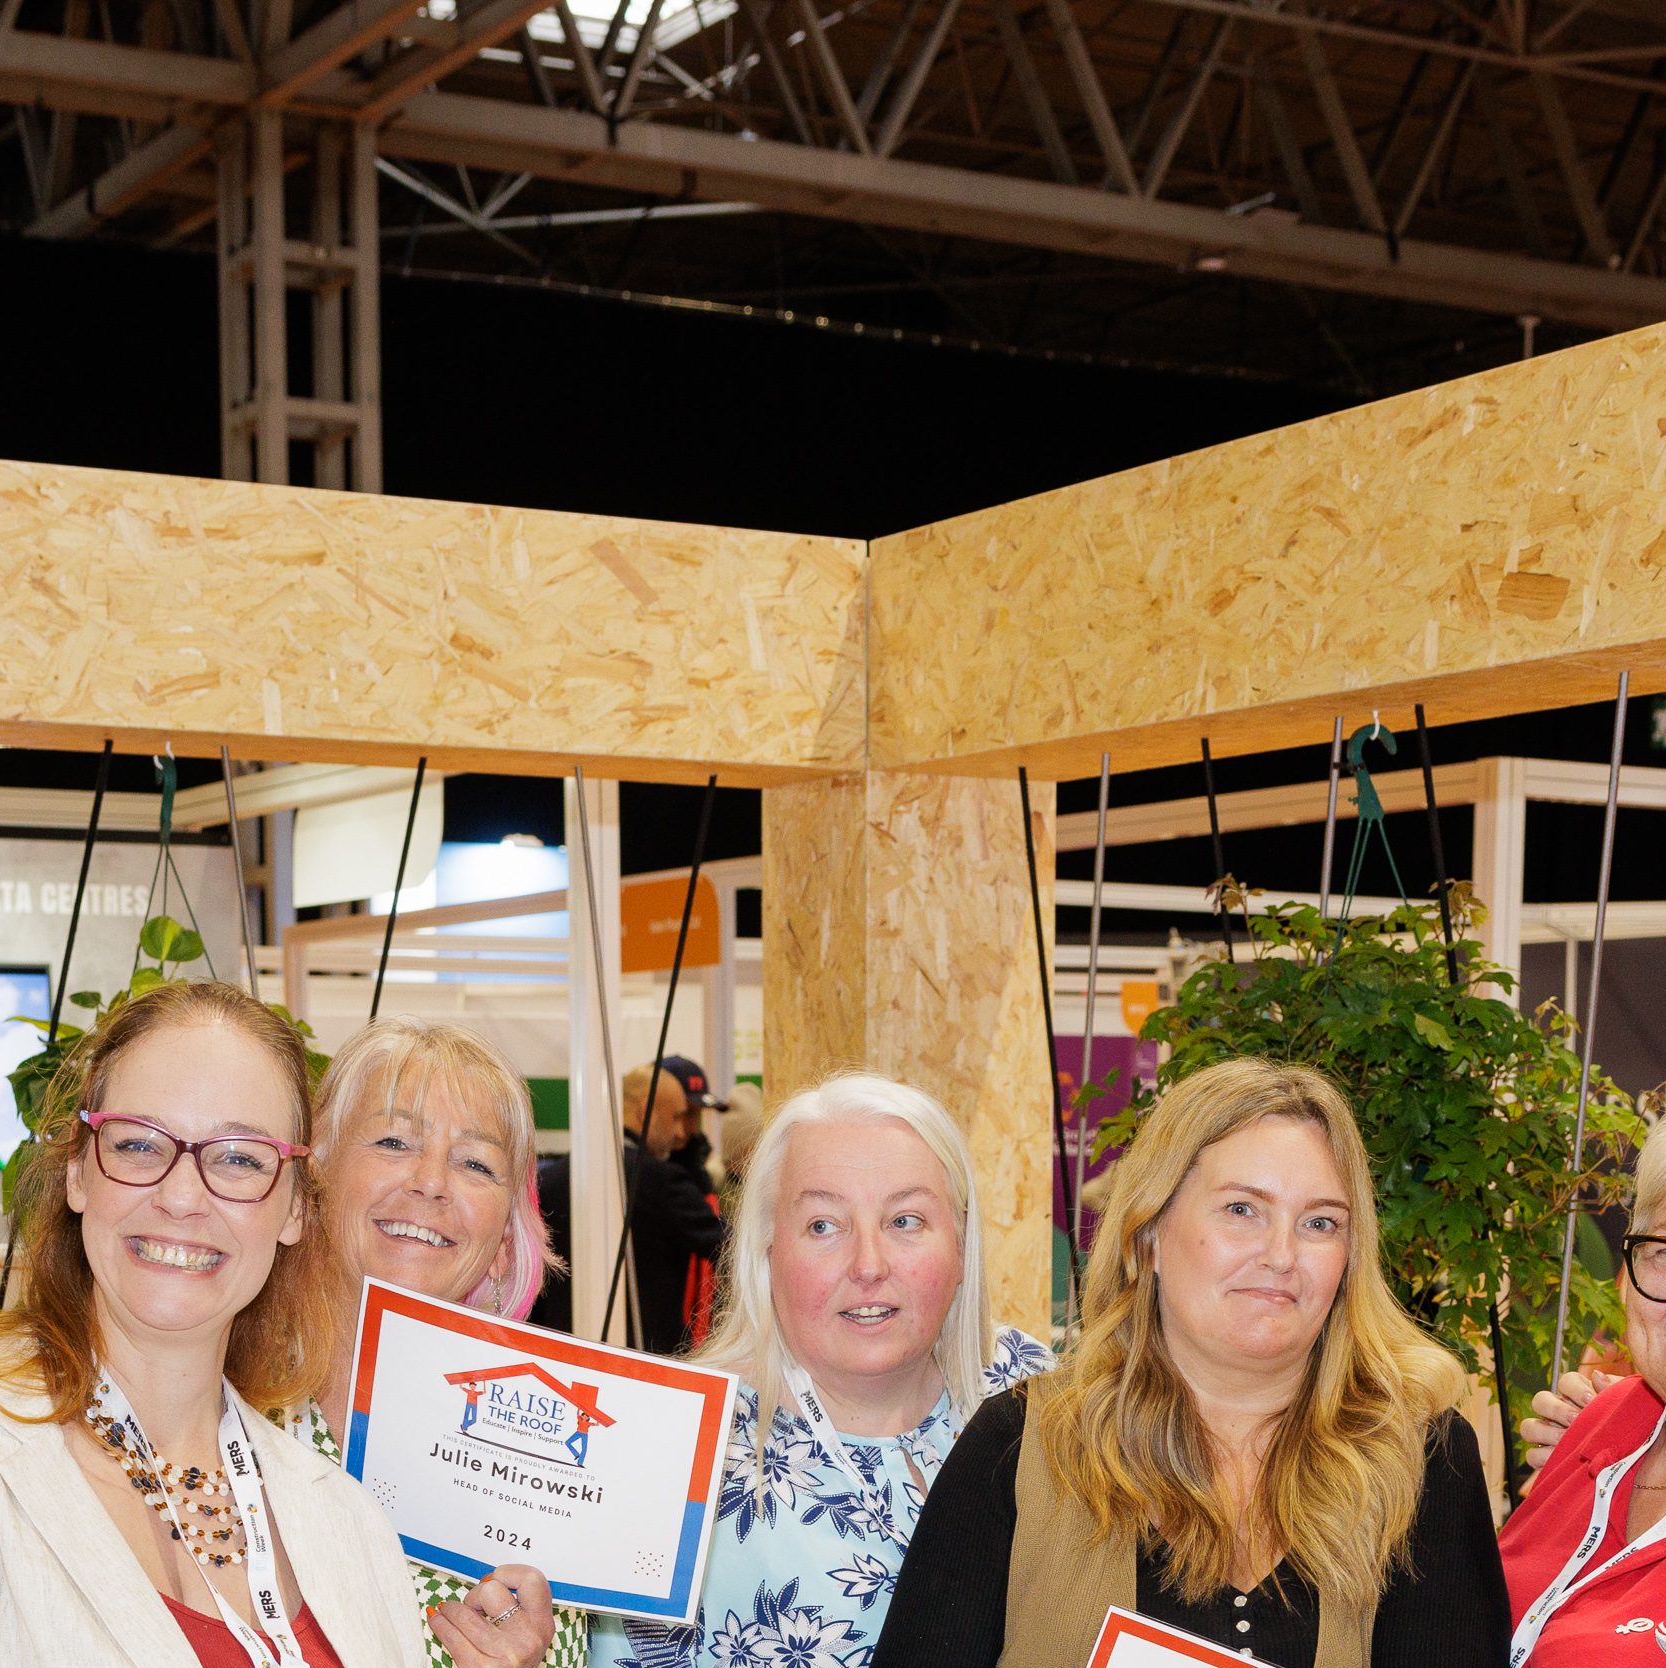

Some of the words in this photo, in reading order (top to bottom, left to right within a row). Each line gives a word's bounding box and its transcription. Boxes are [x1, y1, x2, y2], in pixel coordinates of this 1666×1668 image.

[488, 1382, 566, 1422] RAISE
[800, 1390, 823, 1423] MERS
[488, 1405, 516, 1424] THE
[520, 1414, 562, 1435] ROOF
[227, 1440, 250, 1477] MERS
[429, 1442, 483, 1472] Julie
[491, 1460, 603, 1504] Mirowski
[453, 1477, 478, 1492] HEAD
[482, 1487, 494, 1498] OF
[498, 1492, 534, 1510] SOCIAL
[539, 1504, 572, 1518] MEDIA
[483, 1524, 532, 1551] 2024
[1576, 1525, 1601, 1559] MERS
[259, 1590, 280, 1620] MERS
